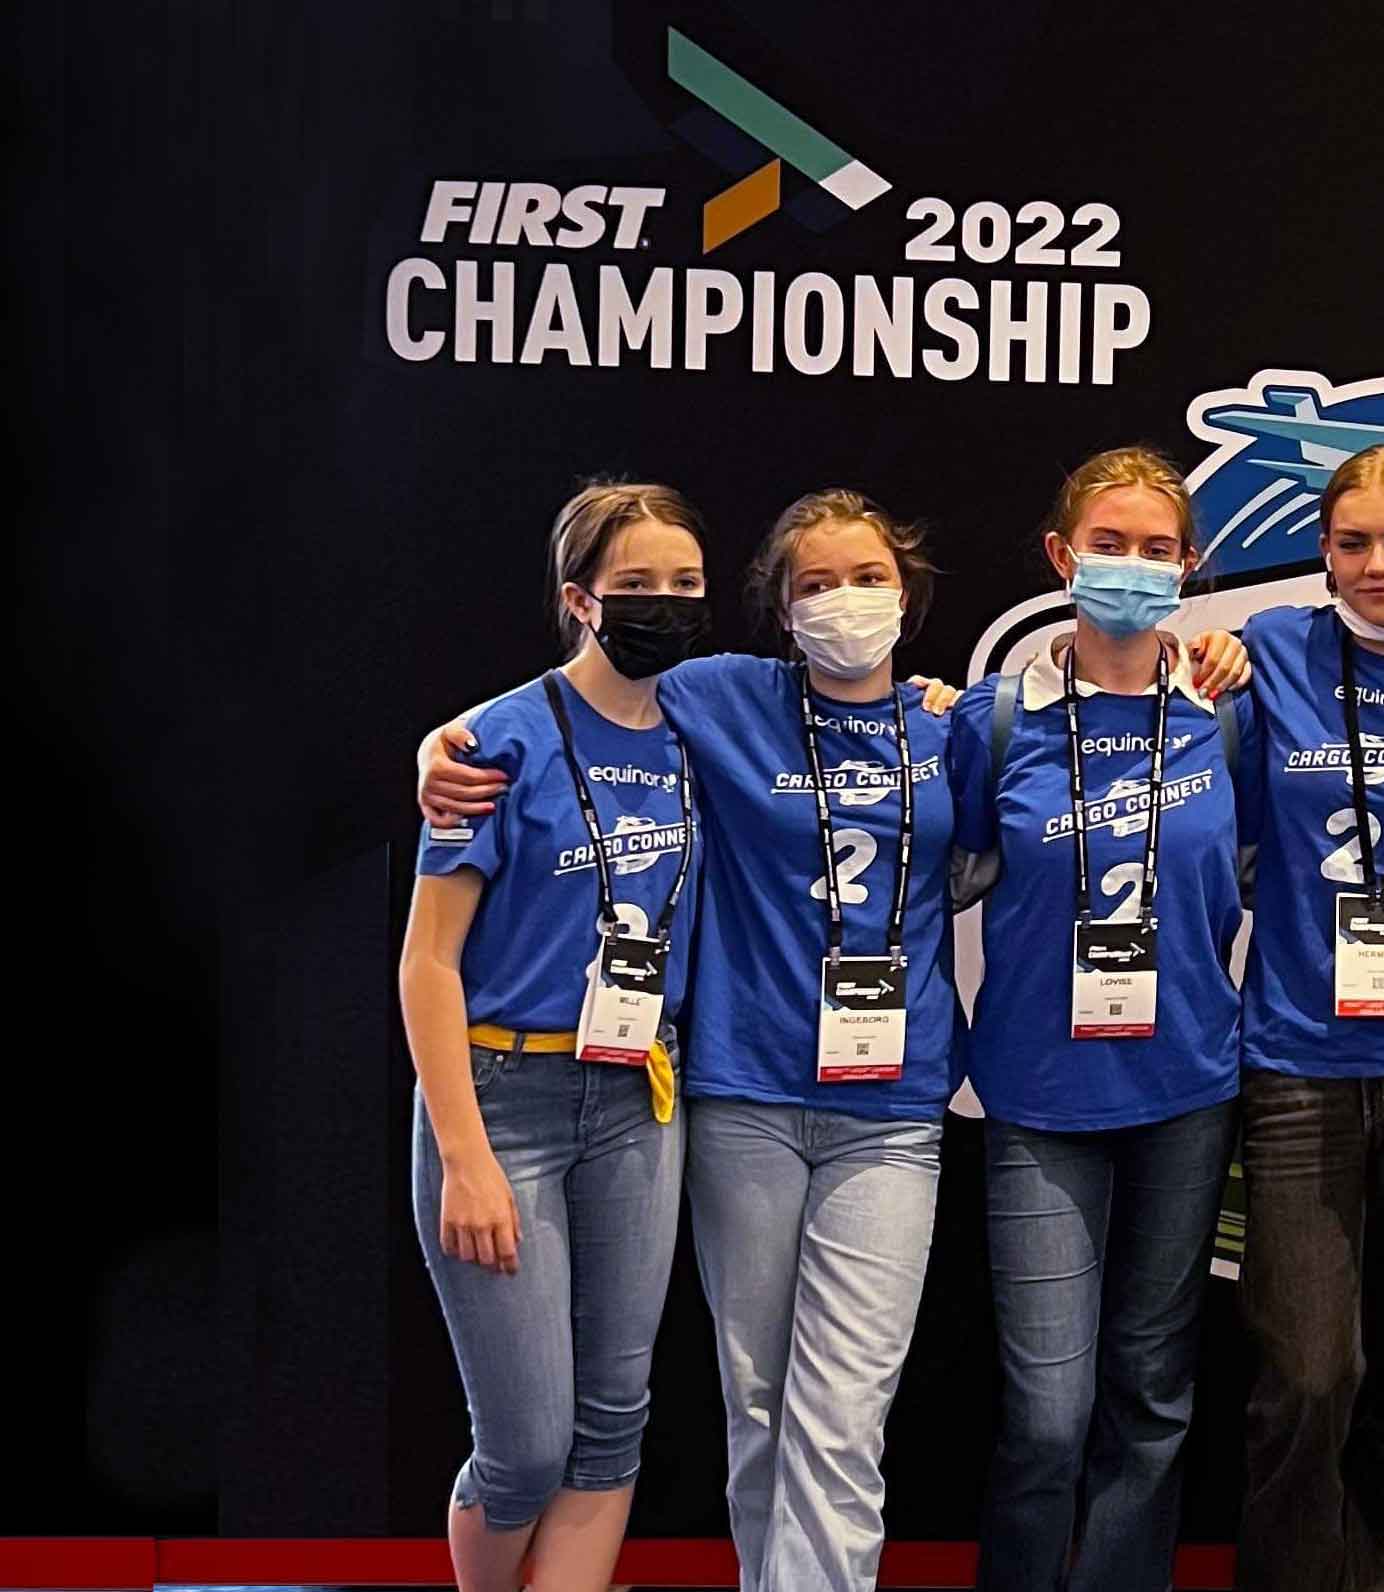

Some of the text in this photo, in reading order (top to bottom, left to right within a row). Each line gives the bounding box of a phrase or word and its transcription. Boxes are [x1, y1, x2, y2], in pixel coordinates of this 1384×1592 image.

[420, 179, 666, 250] FIRST
[904, 197, 1122, 267] 2022
[385, 256, 1152, 385] CHAMPIONSHIP
[588, 764, 661, 787] equinor
[1045, 801, 1117, 835] CAGO
[1320, 807, 1382, 884] 2
[809, 827, 878, 904] 2
